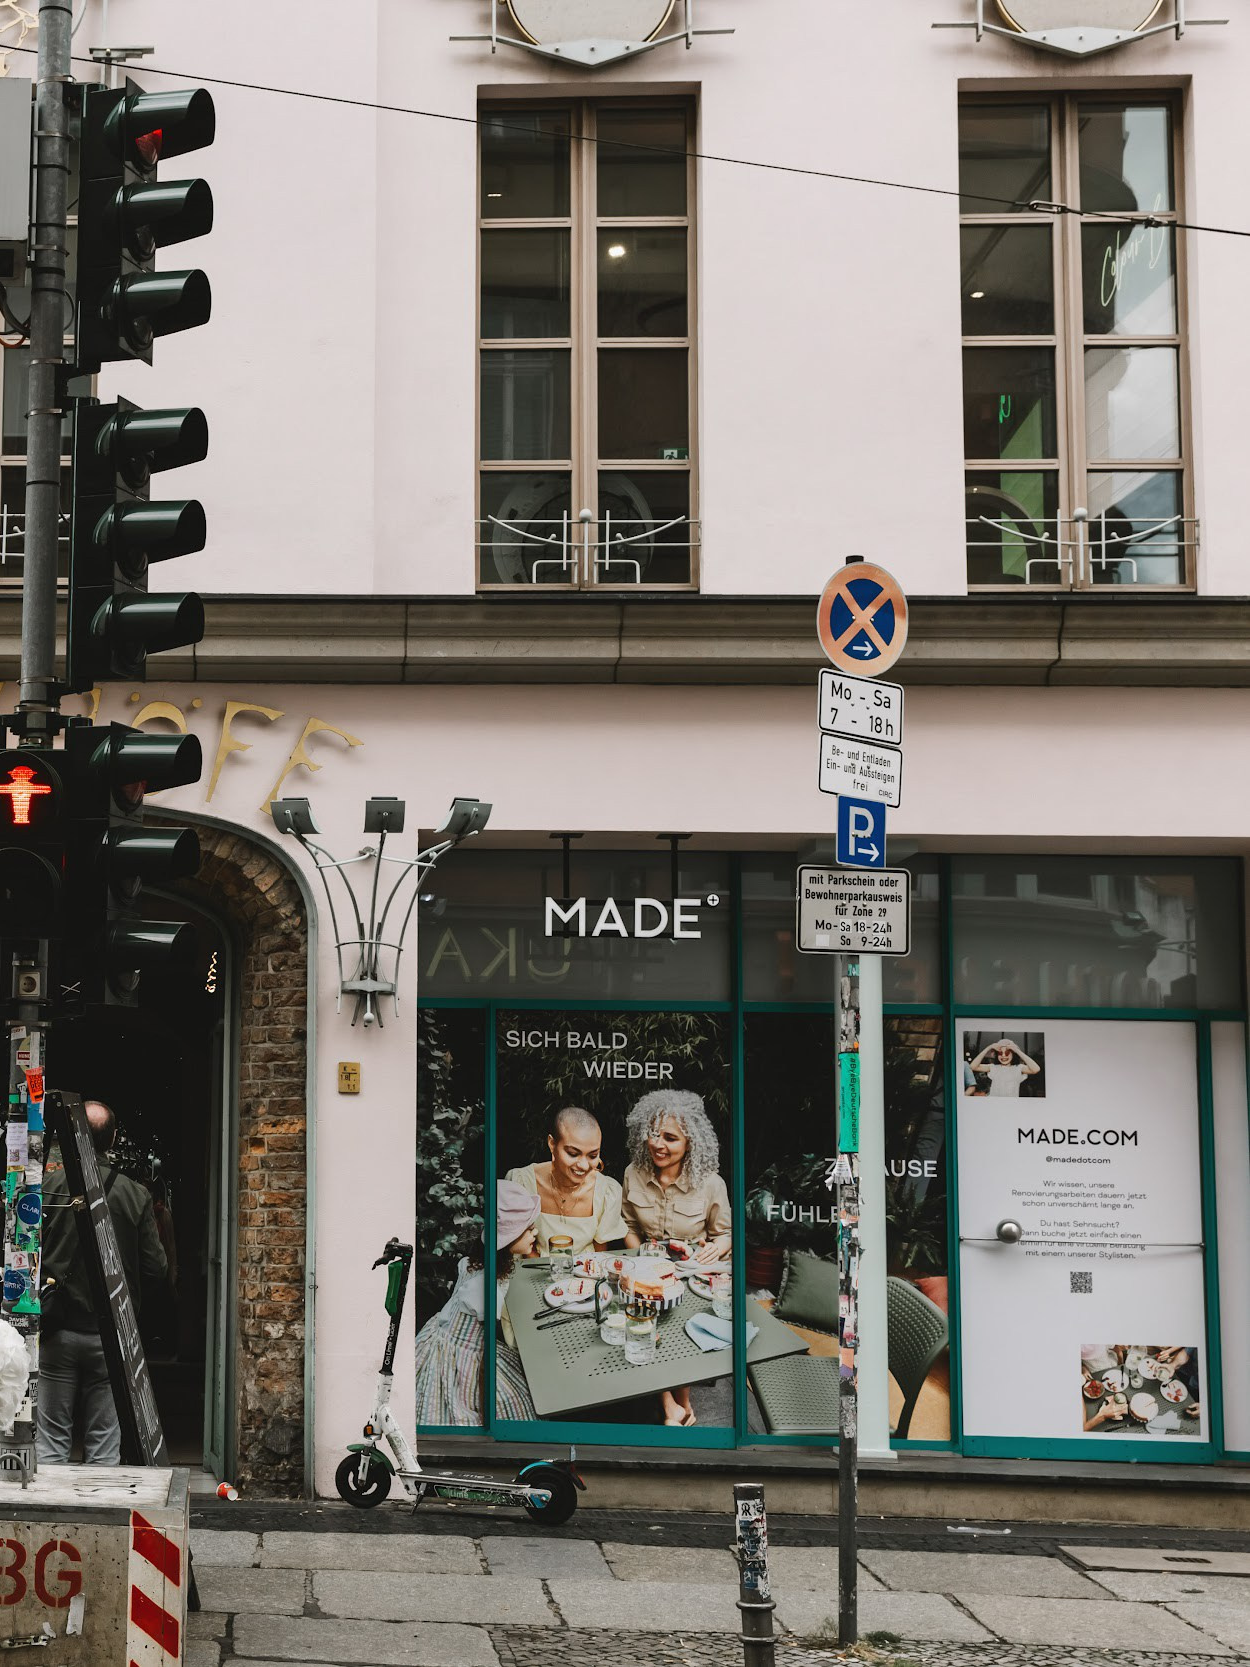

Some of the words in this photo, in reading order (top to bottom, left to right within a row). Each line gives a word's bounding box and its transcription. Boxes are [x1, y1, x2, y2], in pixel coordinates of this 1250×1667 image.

[831, 680, 852, 700] Mo
[873, 689, 891, 709] Sa
[830, 707, 839, 725] 7
[831, 745, 844, 756] Be-
[847, 750, 860, 761] und
[862, 752, 891, 768] Entladen
[826, 758, 841, 770] Ein-
[843, 764, 856, 775] und
[858, 766, 895, 784] Aussteigen
[852, 779, 868, 791] frei
[848, 805, 875, 856] P
[809, 873, 824, 885] mit
[827, 874, 875, 887] Parkschein
[879, 876, 899, 887] oder
[805, 889, 903, 903] Bewohnerparkausweis
[545, 896, 702, 939] MADE
[834, 905, 848, 916] für
[852, 905, 873, 917] Zone
[878, 908, 887, 917] 29
[840, 935, 851, 946] So
[505, 1030, 560, 1048] SICH
[566, 1031, 628, 1050] BALD
[582, 1060, 674, 1080] WIEDER
[1017, 1128, 1138, 1146] MADE.COM
[1045, 1155, 1111, 1164] @madedotcom
[824, 1158, 938, 1178] ZUSE
[1058, 1181, 1087, 1189] wissen,
[1011, 1189, 1096, 1199] Renovierungsarbeiten
[1126, 1192, 1147, 1201] jetzt
[766, 1201, 838, 1223] FÜHLE
[1047, 1201, 1099, 1209] unverschämt
[1100, 1202, 1121, 1210] lange
[1040, 1219, 1051, 1227] Du
[1072, 1220, 1120, 1229] Sehnsucht?
[1067, 1231, 1088, 1239] jetzt
[1089, 1231, 1118, 1239] einfach
